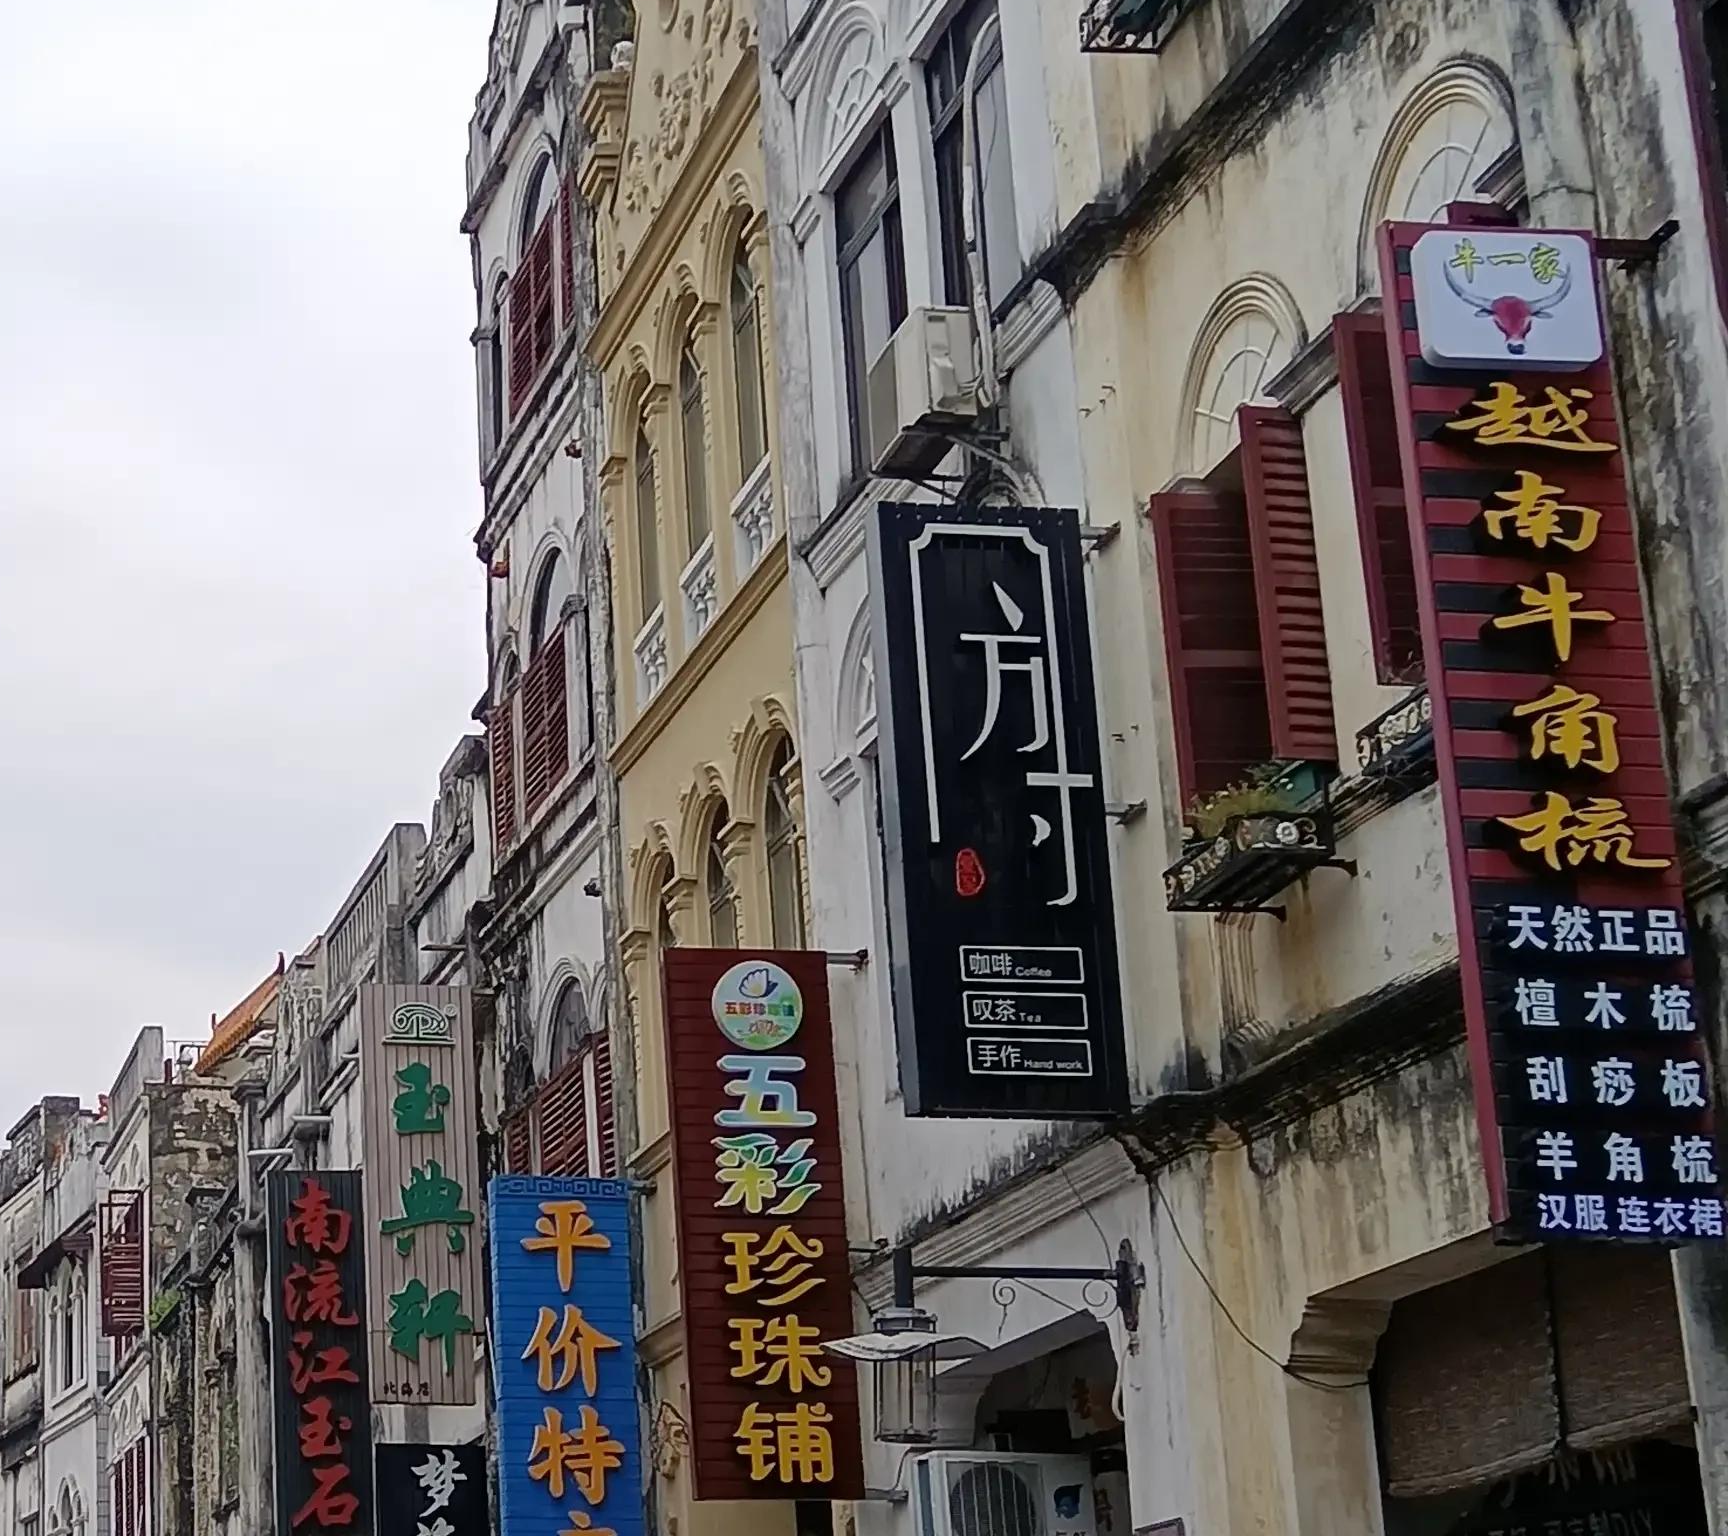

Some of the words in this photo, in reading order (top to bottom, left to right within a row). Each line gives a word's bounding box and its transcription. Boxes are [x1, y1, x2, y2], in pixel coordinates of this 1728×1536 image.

[1446, 381, 1671, 871] 越南牛角梳
[1507, 904, 1687, 956] 天然正品
[969, 952, 1013, 976] 咖啡
[973, 998, 1016, 1022] 叹茶
[1515, 977, 1697, 1032] 檀木梳
[977, 1044, 1021, 1068] 手作
[1526, 1056, 1706, 1109] 刮痧板
[1536, 1131, 1719, 1184] 羊角梳
[711, 1054, 837, 1485] 五彩珍珠铺
[284, 1177, 360, 1528] 南流江玉石
